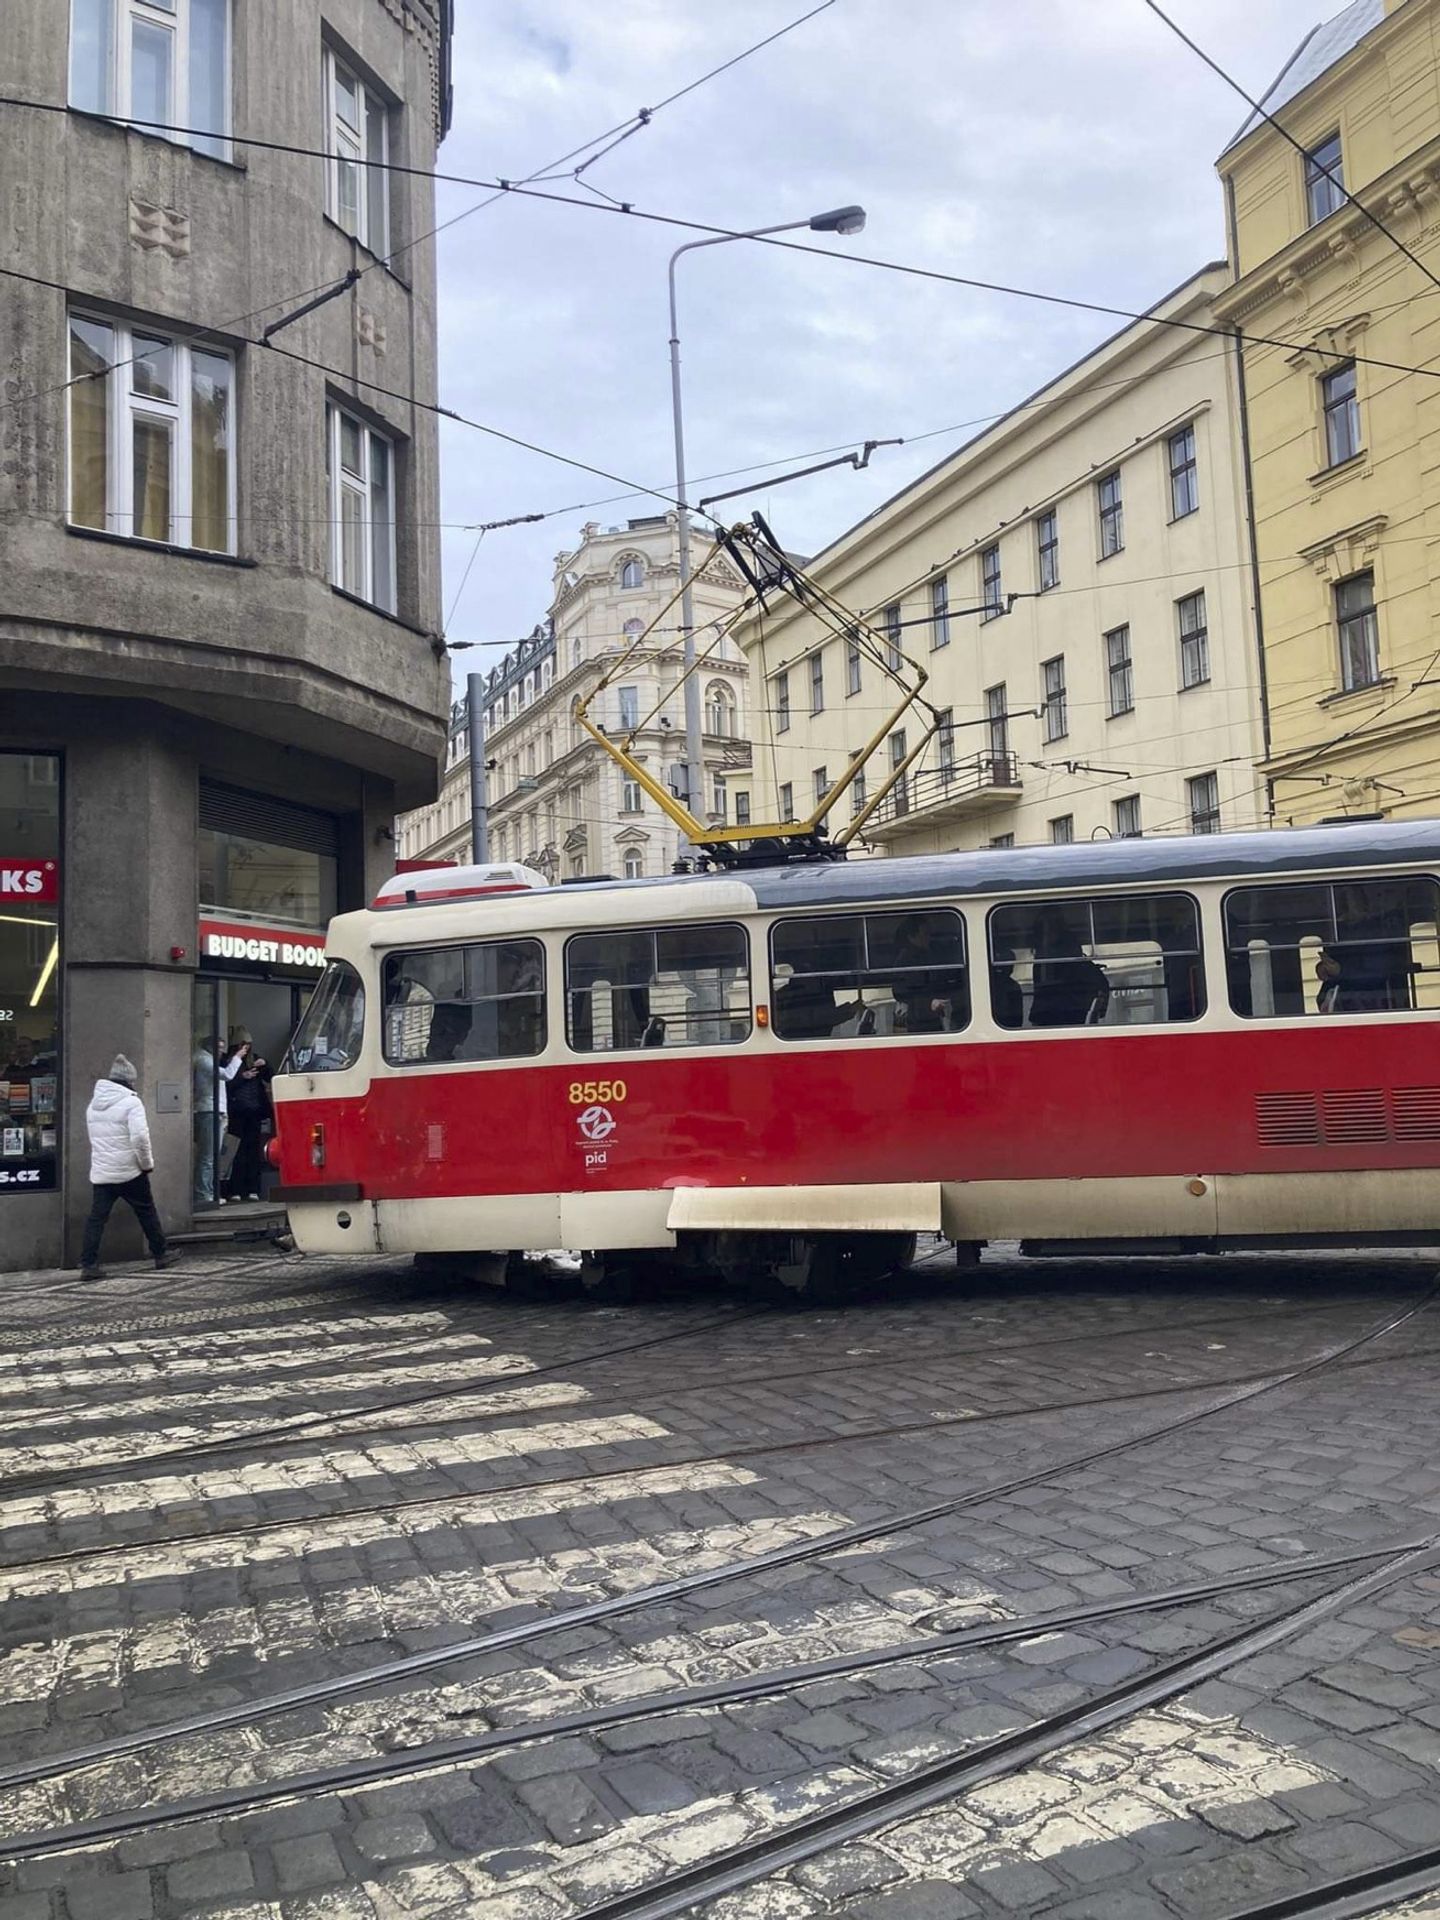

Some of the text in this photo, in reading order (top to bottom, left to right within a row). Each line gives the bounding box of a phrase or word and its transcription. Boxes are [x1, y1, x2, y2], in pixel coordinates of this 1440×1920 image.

[208, 934, 279, 962] BUDGET
[568, 1080, 627, 1104] 8550
[585, 1151, 607, 1167] pid
